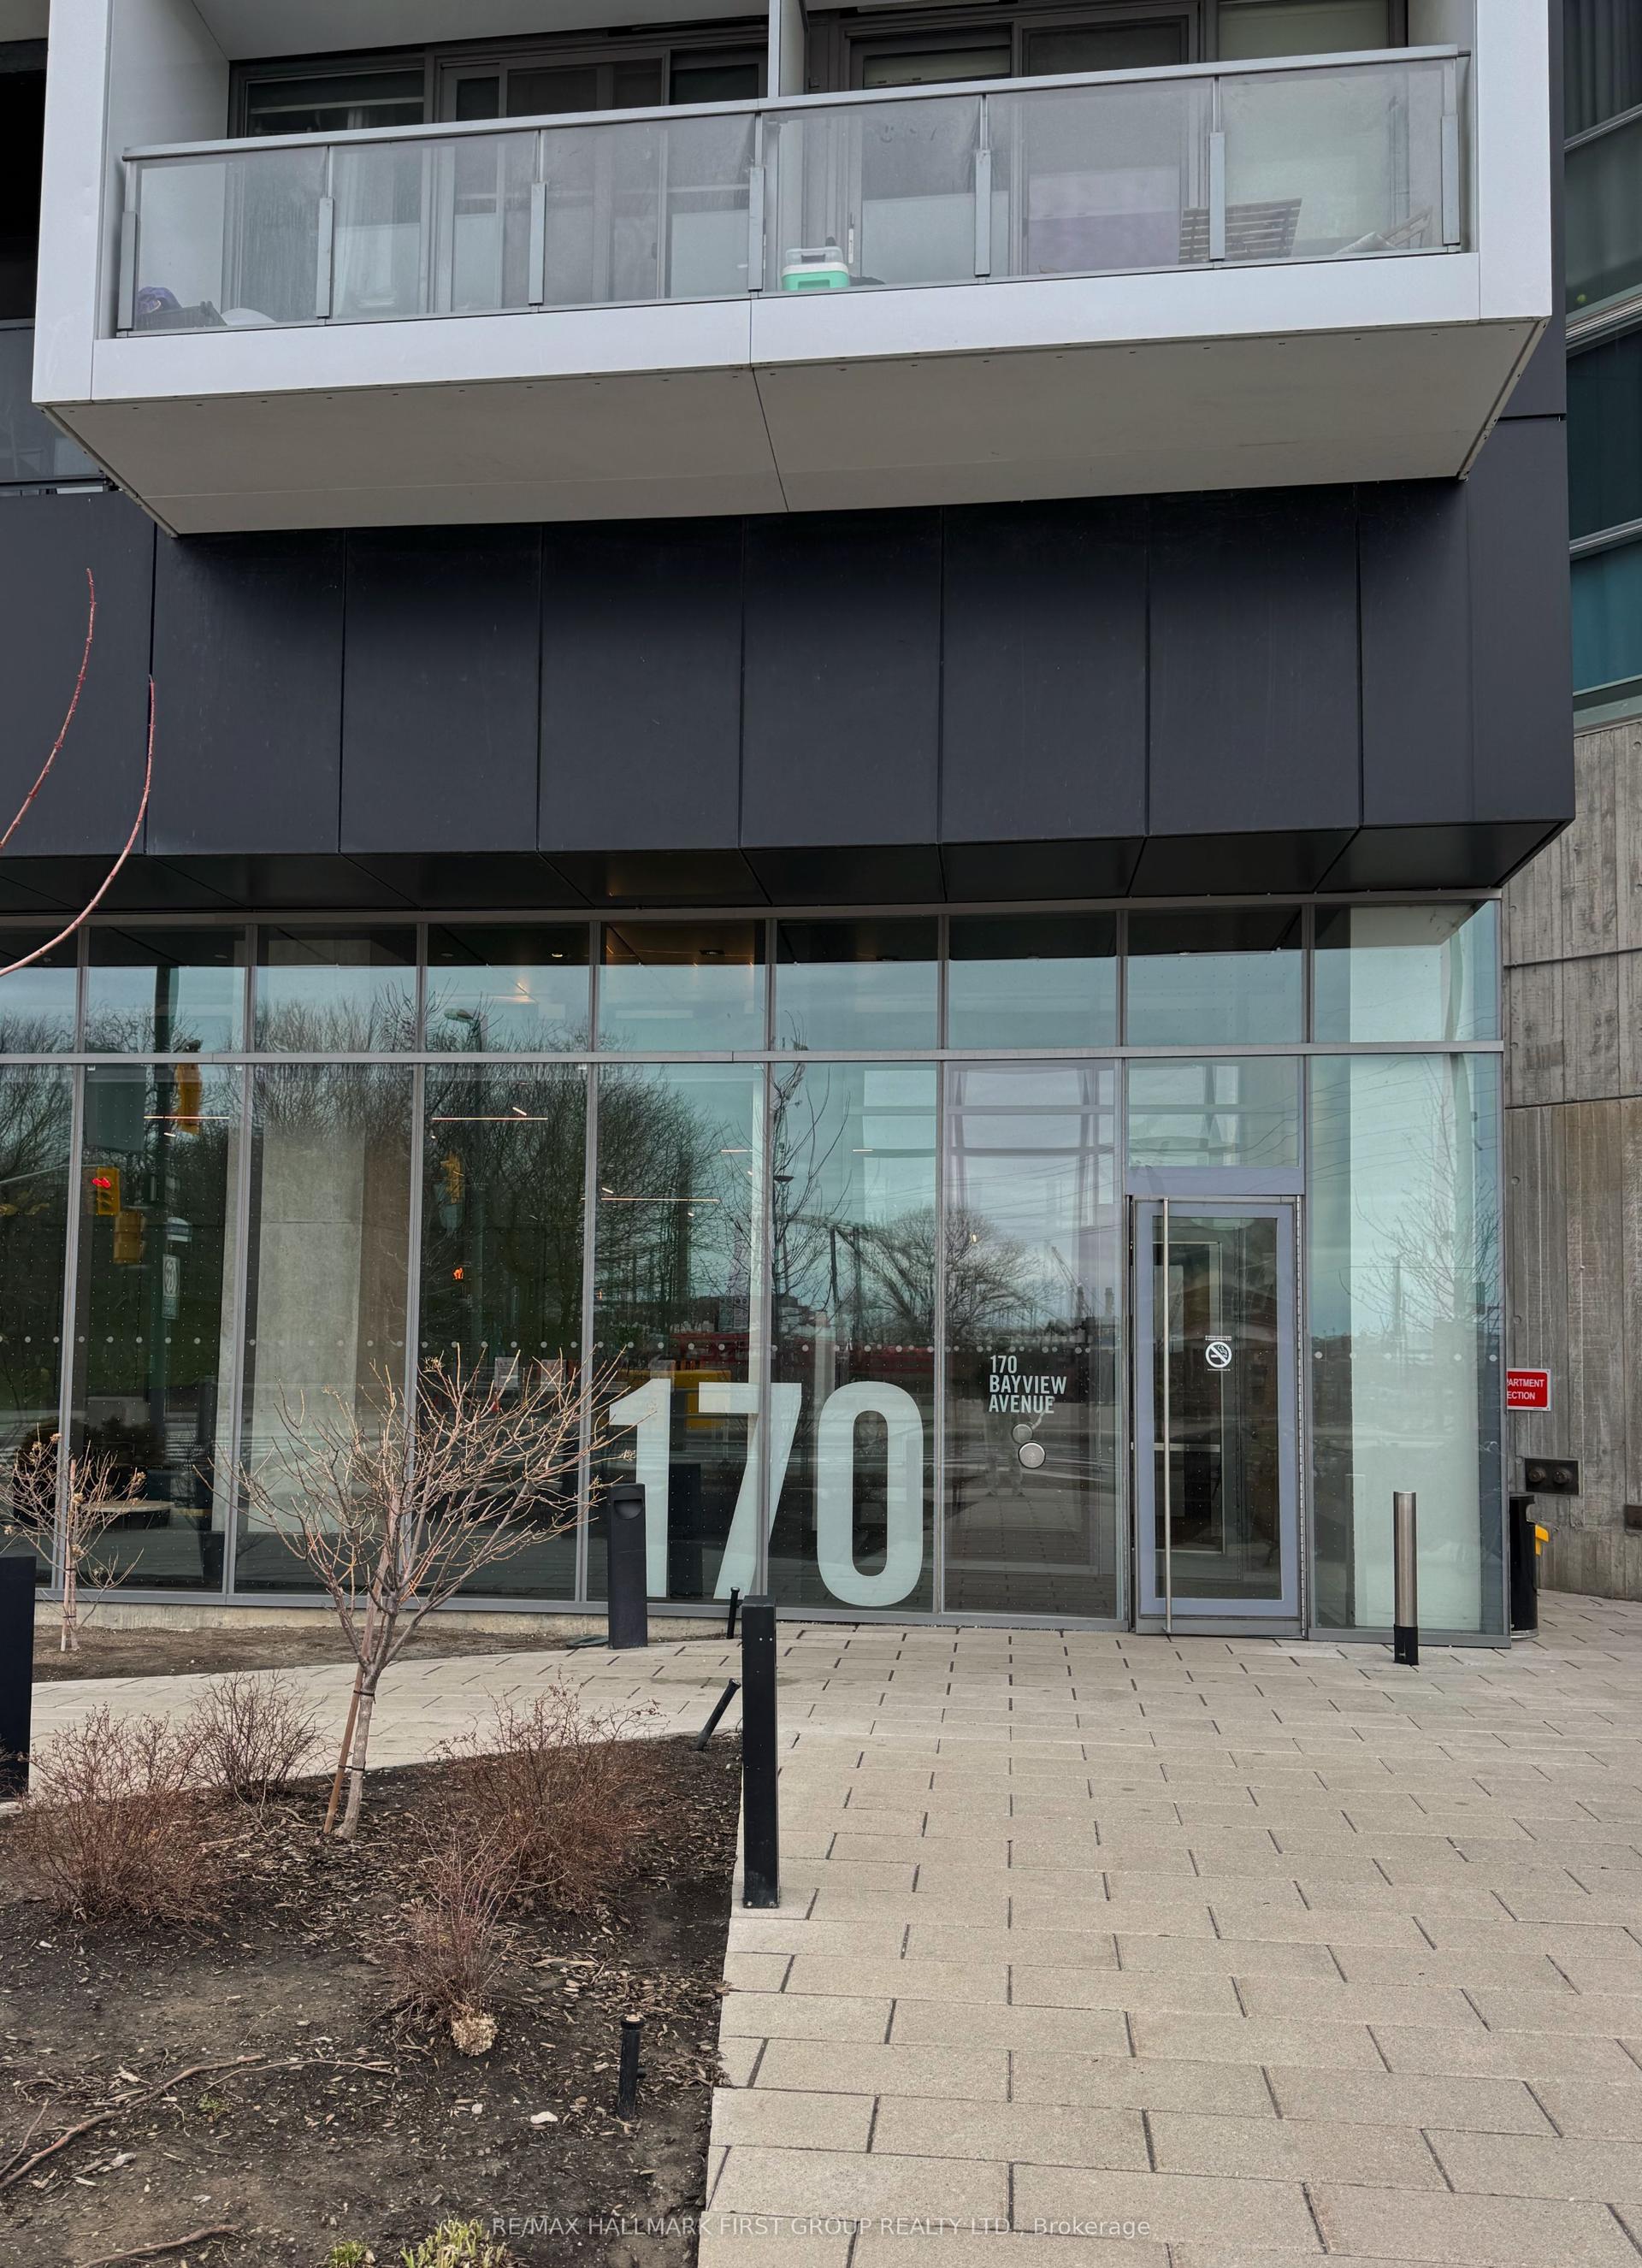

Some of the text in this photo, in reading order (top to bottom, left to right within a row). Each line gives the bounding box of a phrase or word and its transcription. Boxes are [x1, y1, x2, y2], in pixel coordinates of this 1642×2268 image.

[989, 1355, 1018, 1373] 170
[989, 1374, 1067, 1395] BAYVIEW
[1507, 1378, 1545, 1387] ARTMENT
[989, 1394, 1054, 1414] AVENUE
[609, 1378, 924, 1607] 170
